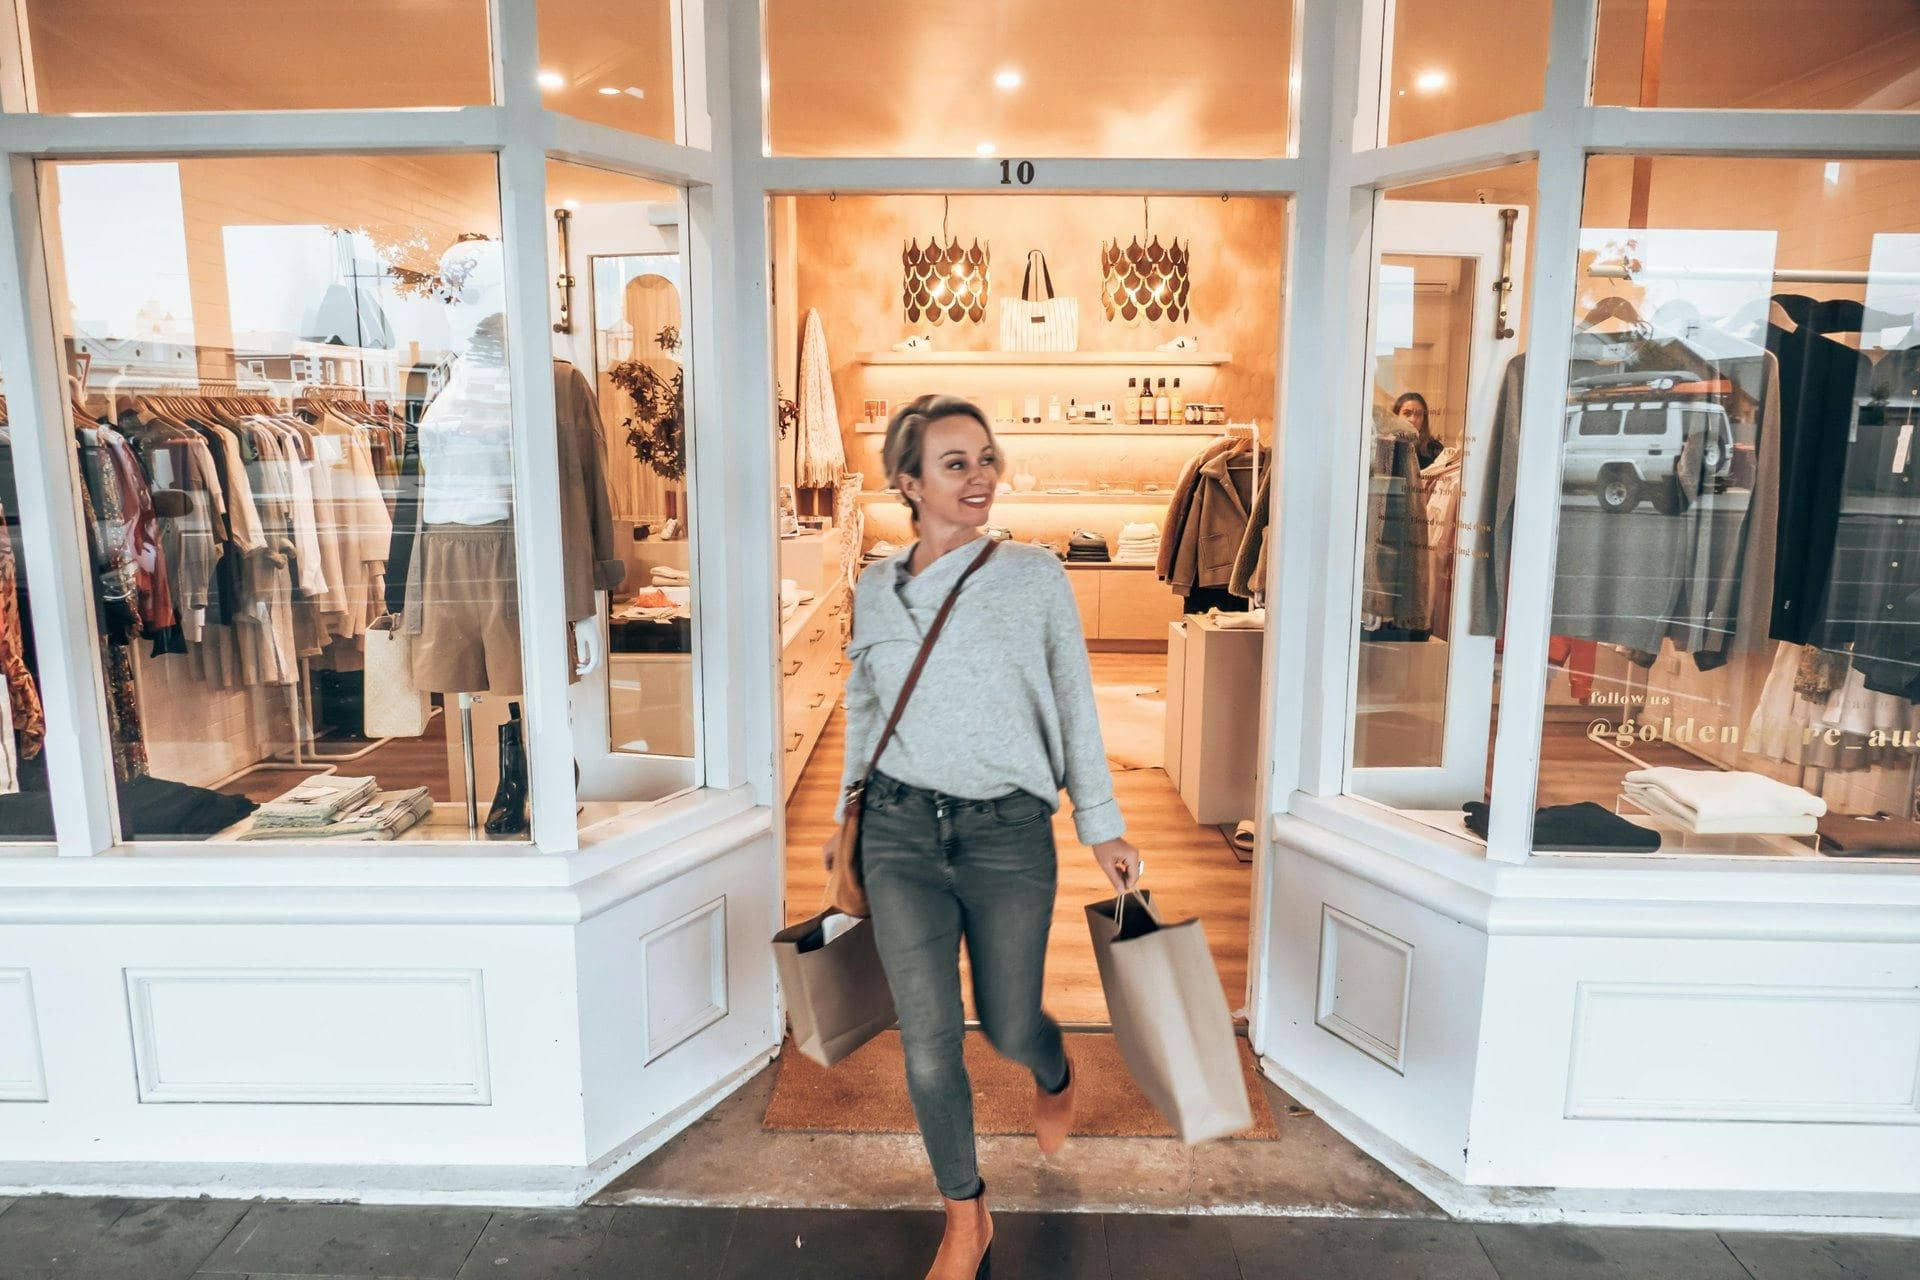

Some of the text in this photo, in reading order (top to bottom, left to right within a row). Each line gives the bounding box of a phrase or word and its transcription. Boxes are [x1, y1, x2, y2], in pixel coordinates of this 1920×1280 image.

[1000, 160, 1035, 185] 10
[1590, 691, 1671, 705] follow us
